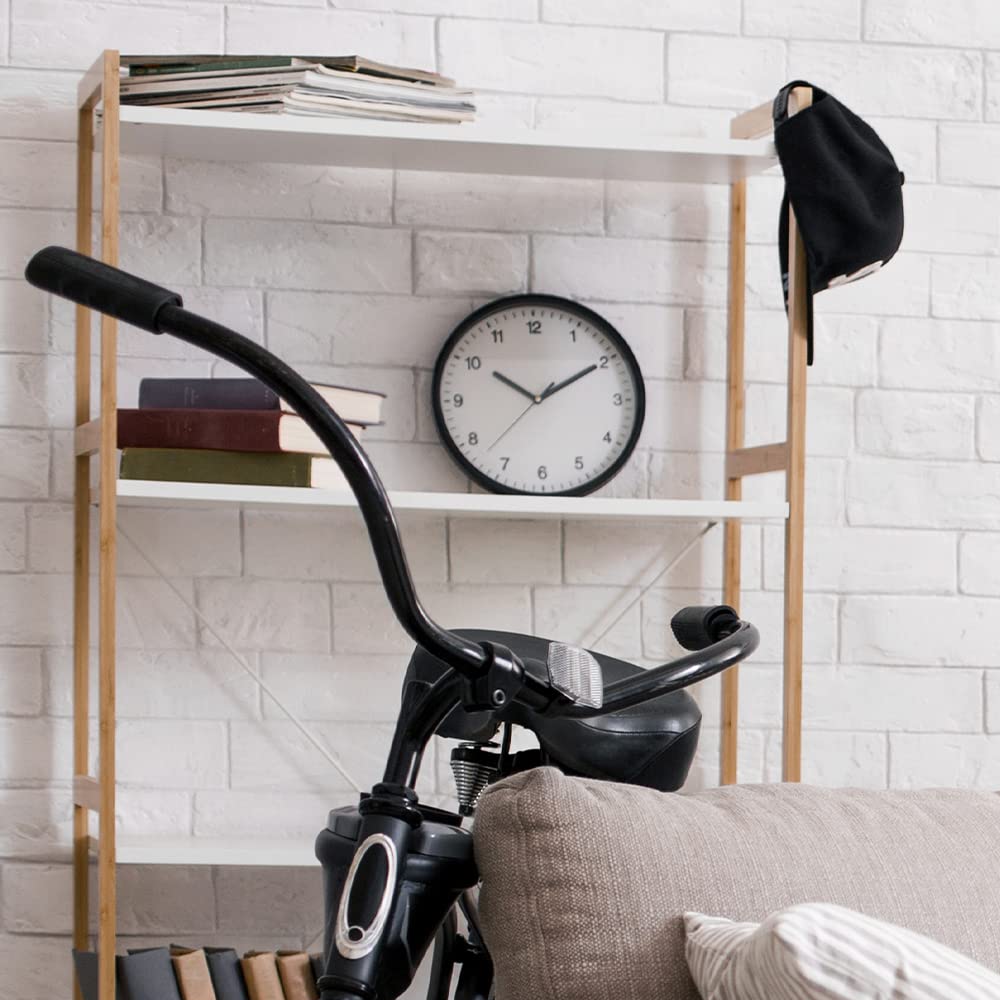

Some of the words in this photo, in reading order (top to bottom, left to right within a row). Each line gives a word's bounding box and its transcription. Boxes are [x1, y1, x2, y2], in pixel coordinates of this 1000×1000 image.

[526, 320, 542, 334] 12
[491, 329, 503, 343] 11
[569, 329, 576, 342] 1
[465, 356, 482, 370] 10
[599, 356, 609, 369] 2
[453, 394, 464, 408] 9
[612, 393, 623, 406] 3
[468, 432, 479, 446] 8
[602, 431, 612, 444] 4
[500, 457, 510, 471] 7
[574, 456, 584, 470] 5
[537, 466, 548, 480] 6
